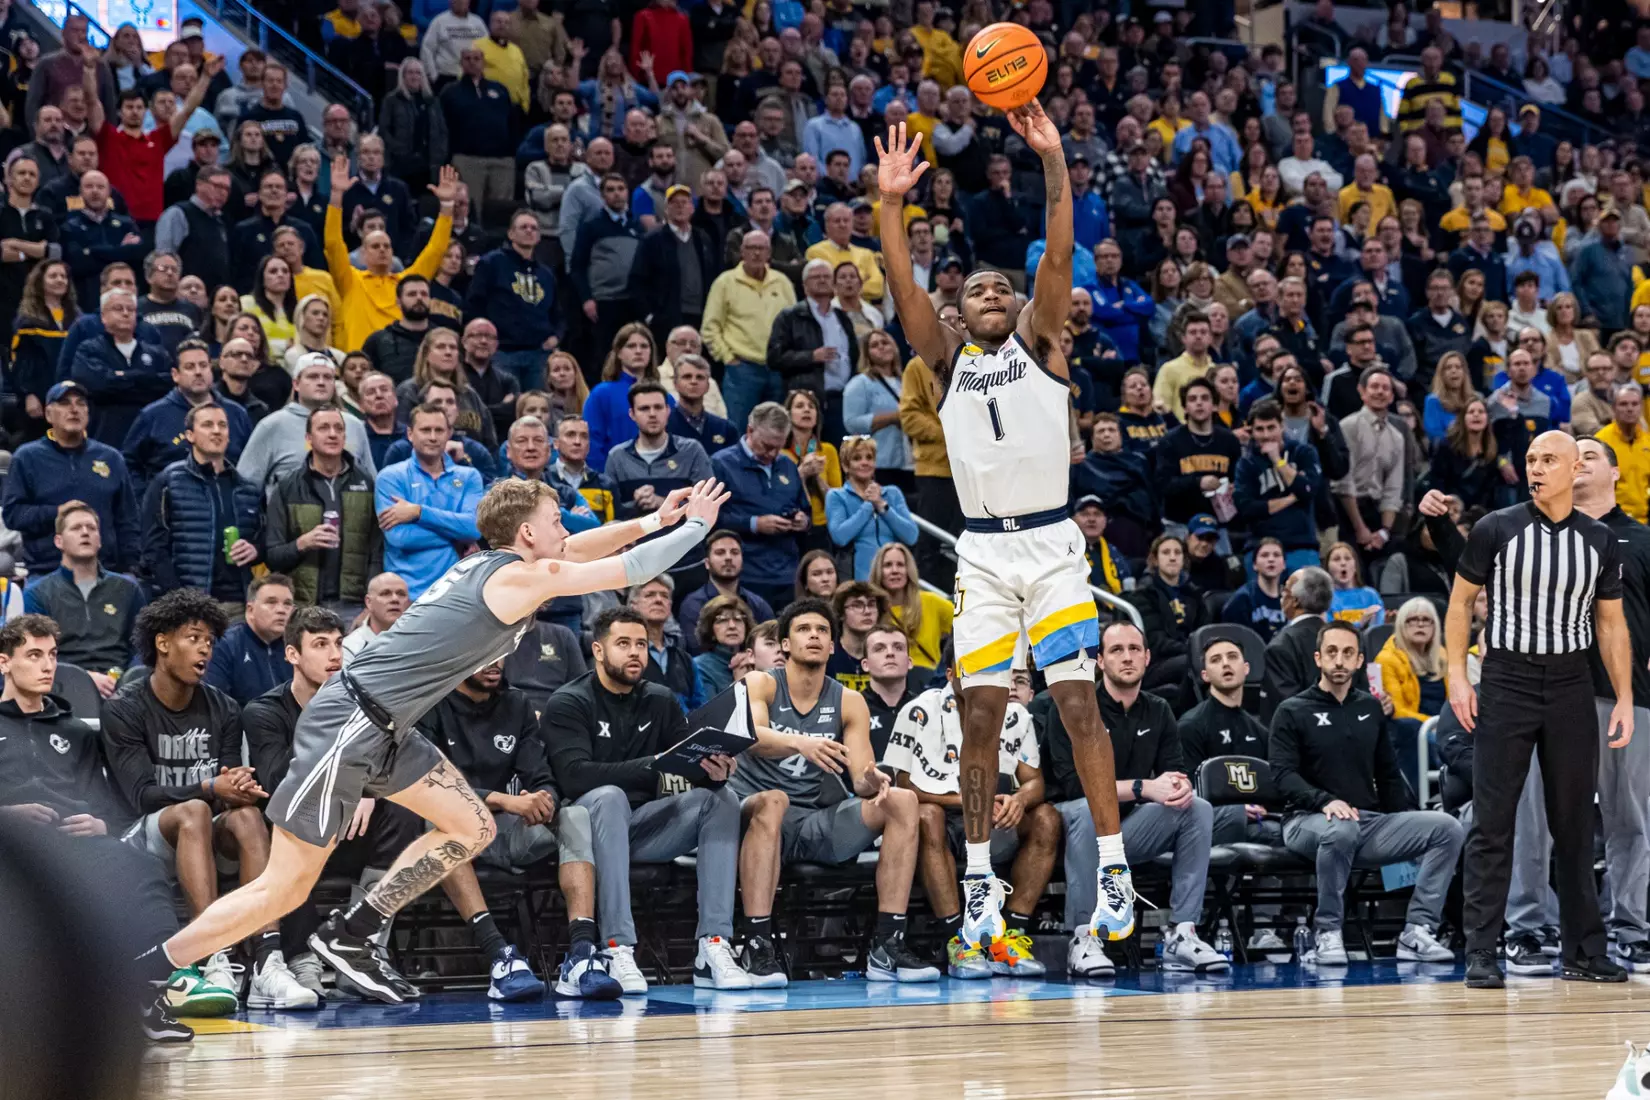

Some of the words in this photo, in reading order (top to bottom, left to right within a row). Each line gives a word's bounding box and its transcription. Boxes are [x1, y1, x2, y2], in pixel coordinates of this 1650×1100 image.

[986, 56, 1028, 83] ELITE
[956, 358, 1027, 395] Maquette
[987, 398, 1005, 441] 1
[1003, 518, 1020, 531] AL
[597, 720, 611, 738] X
[870, 715, 883, 730] X
[1313, 712, 1332, 726] X
[1219, 729, 1232, 744] X
[779, 753, 808, 777] 4
[888, 731, 949, 781] ATRADE
[1225, 763, 1258, 793] MU
